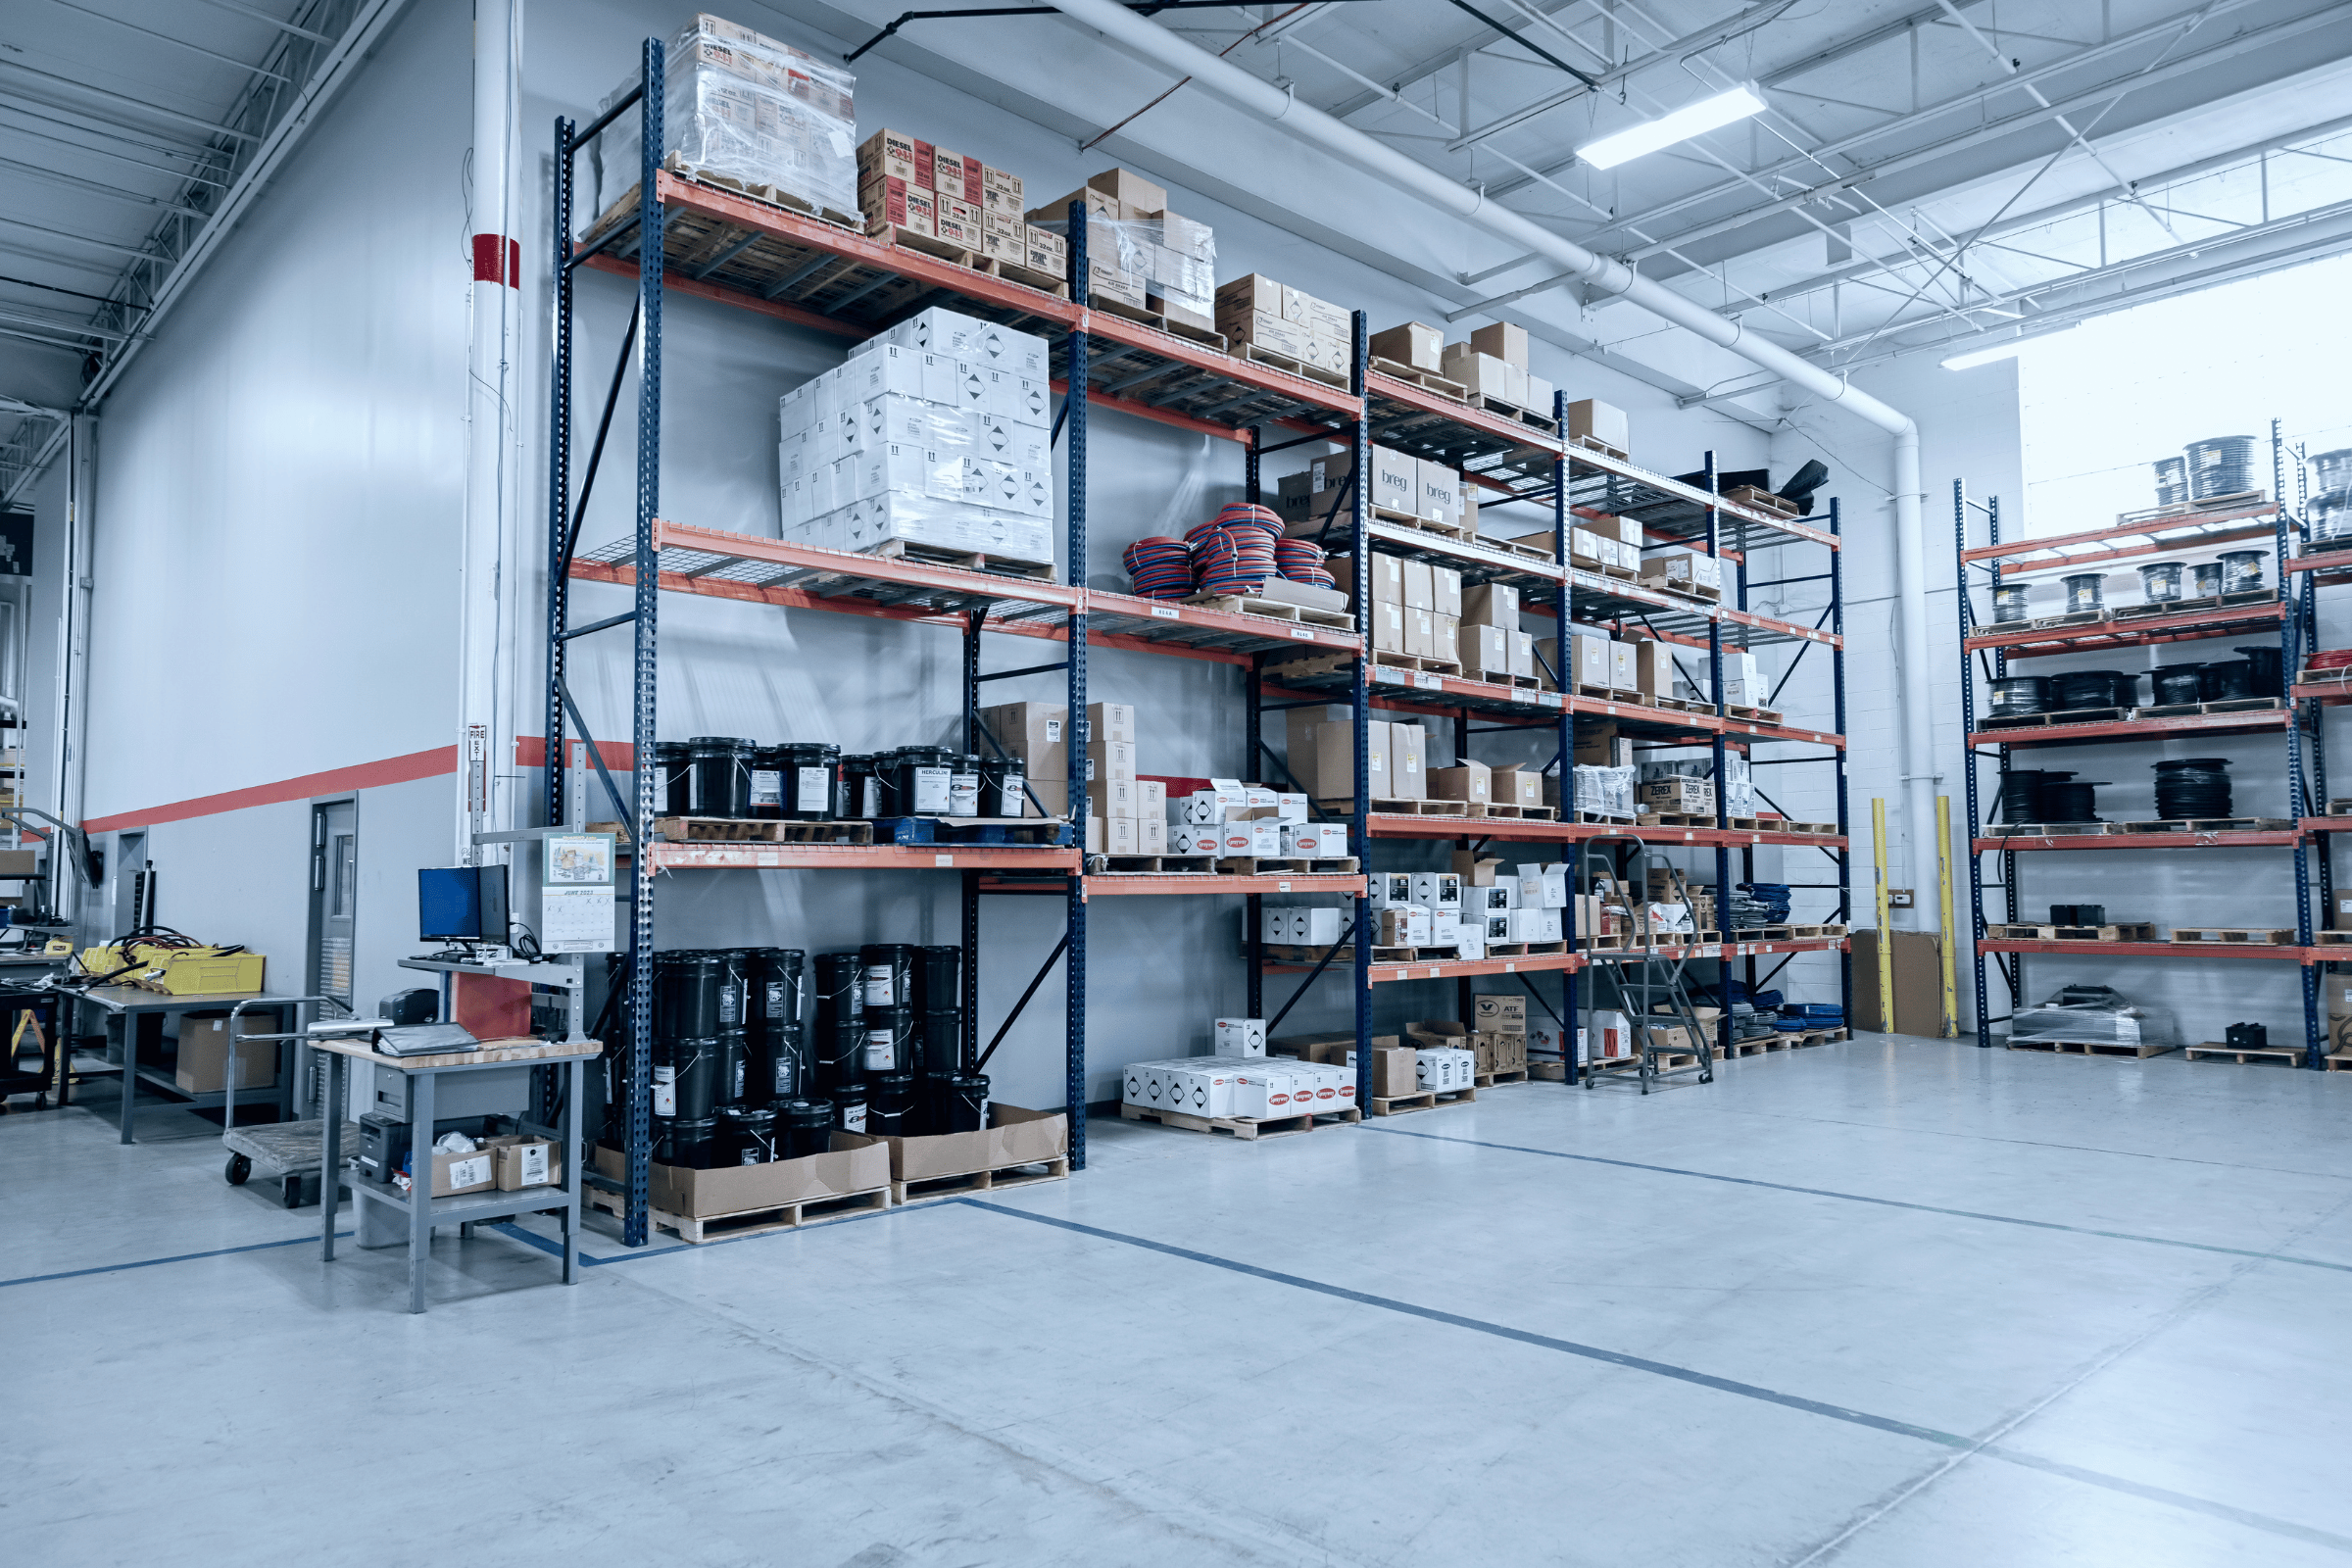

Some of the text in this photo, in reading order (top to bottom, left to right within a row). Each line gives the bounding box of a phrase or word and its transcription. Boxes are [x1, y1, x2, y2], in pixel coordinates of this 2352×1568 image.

[887, 138, 912, 152] DIESEL
[937, 155, 961, 169] DIESEL
[908, 195, 932, 209] DIESEL
[941, 219, 962, 231] DIESEL
[1382, 469, 1407, 492] breg
[1427, 483, 1451, 505] breg
[470, 730, 484, 739] FIRE
[1651, 785, 1671, 796] ZEREX
[1685, 784, 1700, 794] ZEREX
[1704, 788, 1712, 797] REX
